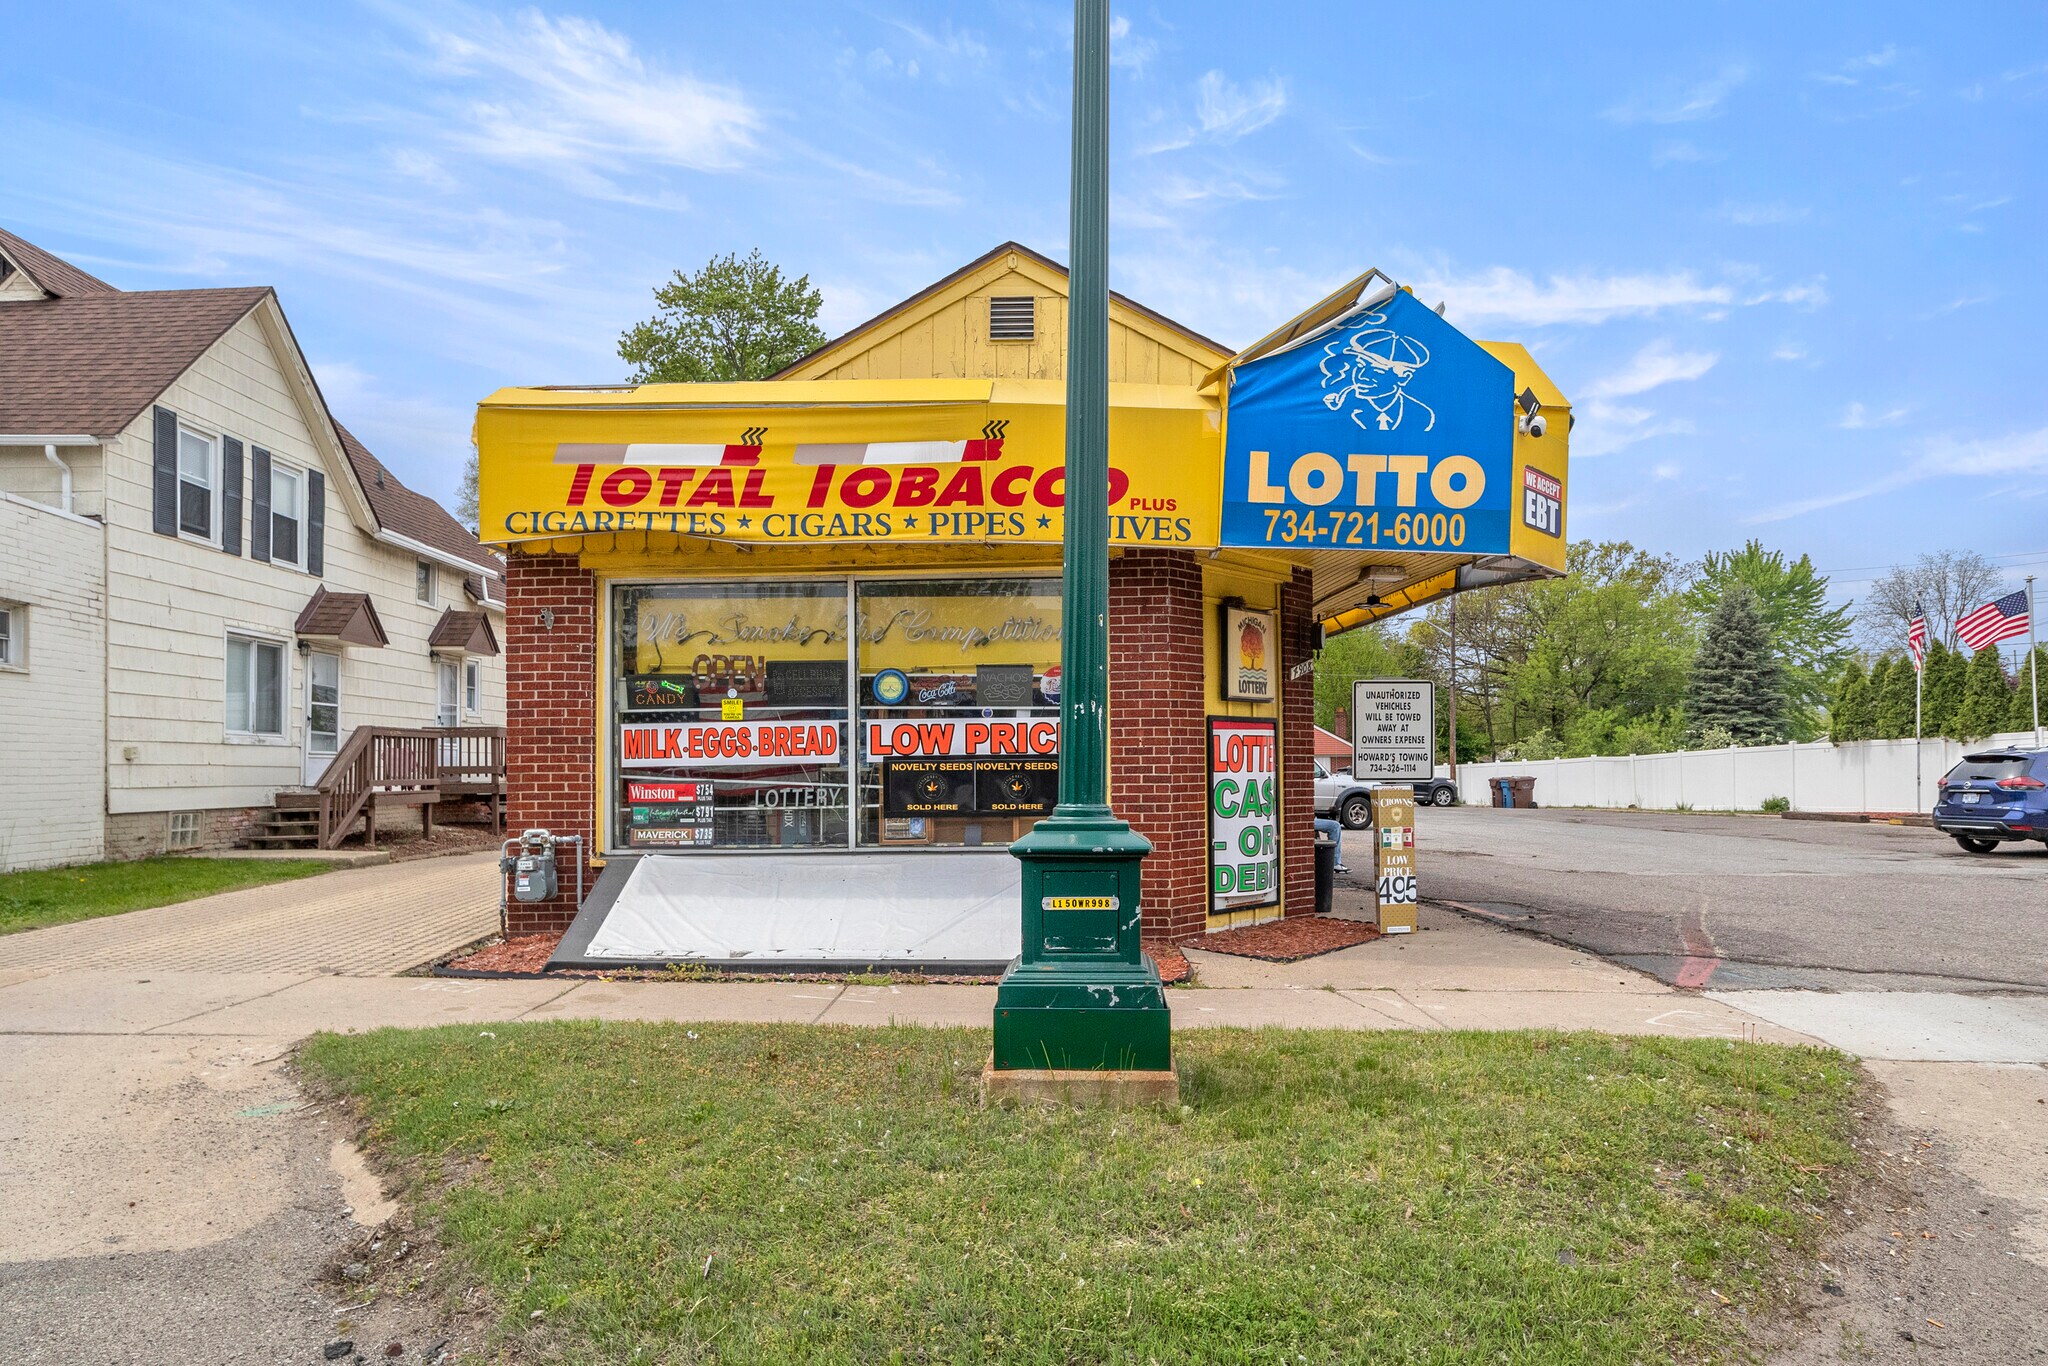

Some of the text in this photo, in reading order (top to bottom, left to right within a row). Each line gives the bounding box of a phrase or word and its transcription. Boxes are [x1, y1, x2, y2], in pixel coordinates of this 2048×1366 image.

[1247, 450, 1486, 509] LOTTO
[1525, 471, 1560, 498] WE ACCEPT
[566, 463, 775, 509] TOTAL
[1130, 498, 1177, 511] PLUS
[1525, 489, 1559, 534] EBT
[505, 510, 1192, 542] CIGARETTES CIGARS PIPES IVES
[1264, 509, 1466, 547] 734-721-6000
[641, 610, 689, 643] We
[716, 611, 811, 647] Smoke
[1237, 616, 1267, 635] MICHIGAN
[692, 653, 765, 692] OPEN
[981, 672, 1029, 683] NACHOS
[1238, 679, 1268, 695] LOTTERY
[635, 693, 686, 705] CANDY
[1365, 691, 1421, 700] UNAUTHORIZED
[1375, 702, 1411, 711] VEHICHLES
[1365, 713, 1421, 722] WILL BE TOWED
[1377, 724, 1409, 732] AWAY AT
[870, 722, 1061, 756] LOW PRIC
[1361, 735, 1425, 744] OWNERS EXPENSE
[1358, 752, 1428, 762] HOWARD'S TOWING
[891, 763, 973, 771] NOVELTY SEEDS
[976, 762, 1058, 770] NOVELTY SEEDS
[1370, 763, 1416, 773] 734-326-1114
[630, 785, 675, 800] Winston
[755, 787, 841, 808] LOTTERY
[1380, 798, 1413, 808] CROWNS
[637, 830, 688, 839] MAVERICK
[1238, 825, 1274, 858] OR
[1387, 856, 1409, 865] LOW
[1384, 867, 1413, 877] PRICE
[1379, 876, 1416, 904] 495
